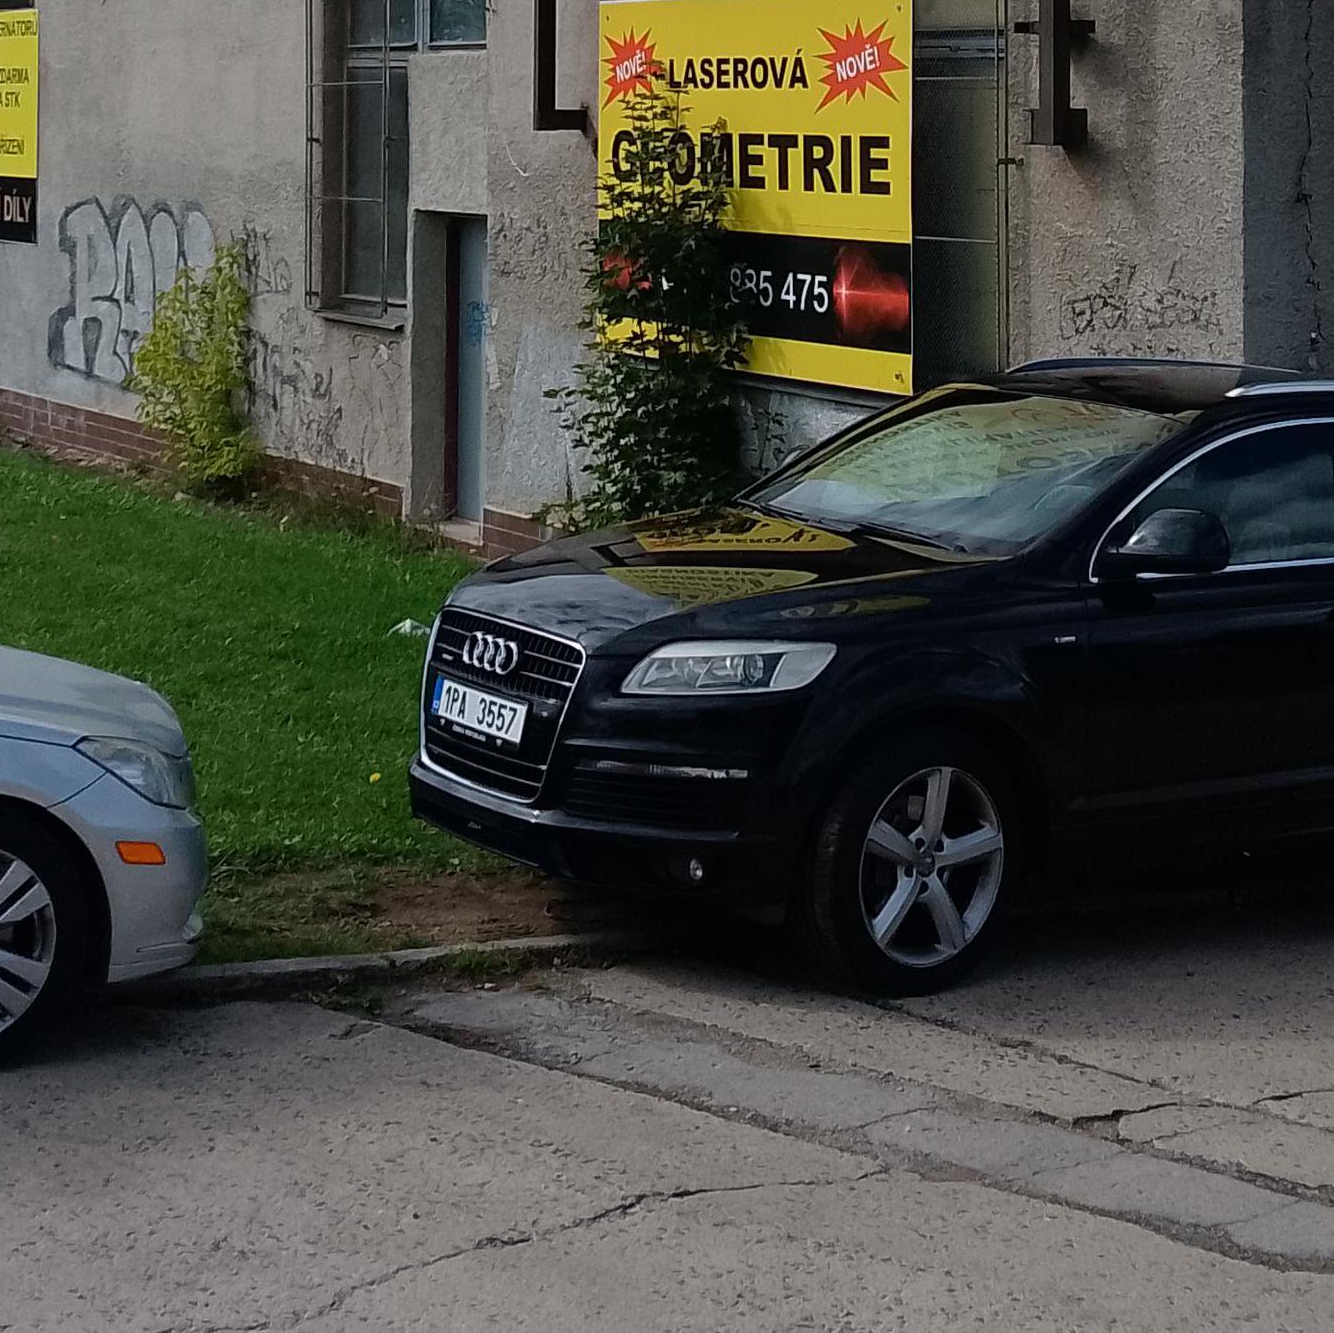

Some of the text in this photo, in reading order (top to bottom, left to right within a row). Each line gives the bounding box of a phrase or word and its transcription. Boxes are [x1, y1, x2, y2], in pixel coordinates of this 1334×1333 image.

[668, 48, 809, 91] LASEROVÁ
[3, 188, 32, 223] DÍLY
[780, 273, 829, 313] 475
[445, 686, 467, 719] 1PA
[477, 698, 517, 734] 3557
